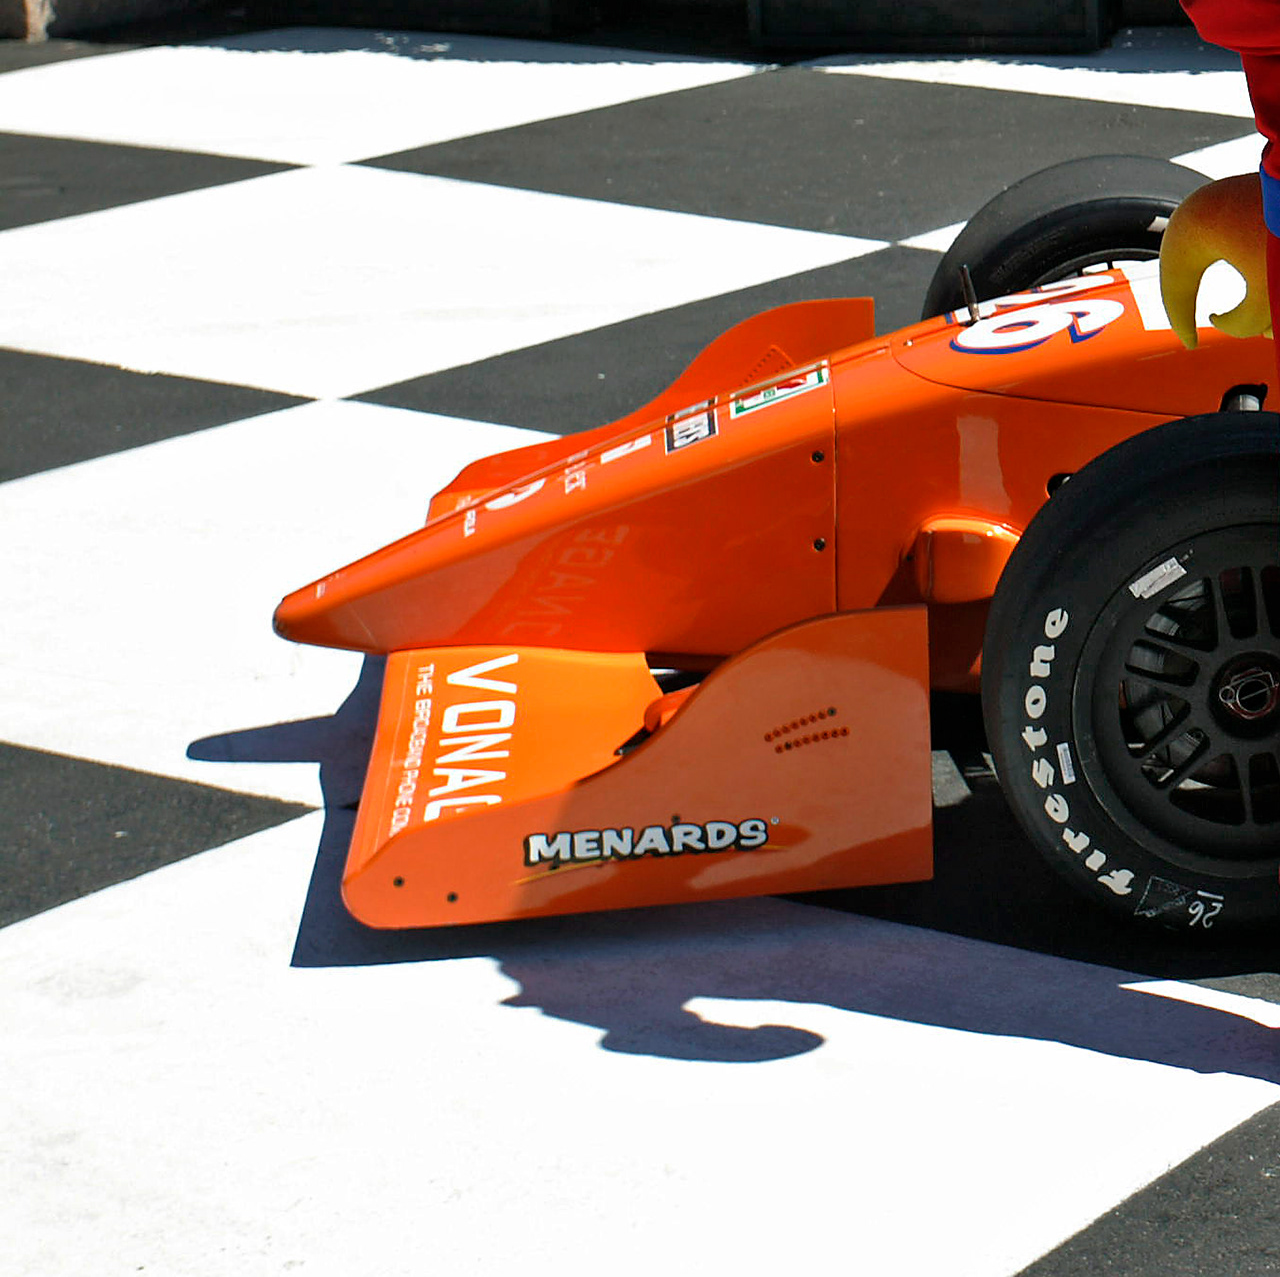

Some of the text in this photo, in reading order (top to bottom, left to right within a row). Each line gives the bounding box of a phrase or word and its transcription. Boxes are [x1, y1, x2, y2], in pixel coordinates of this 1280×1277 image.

[416, 663, 435, 696] THE
[1021, 606, 1135, 897] Firestone
[522, 816, 769, 870] MENARDS
